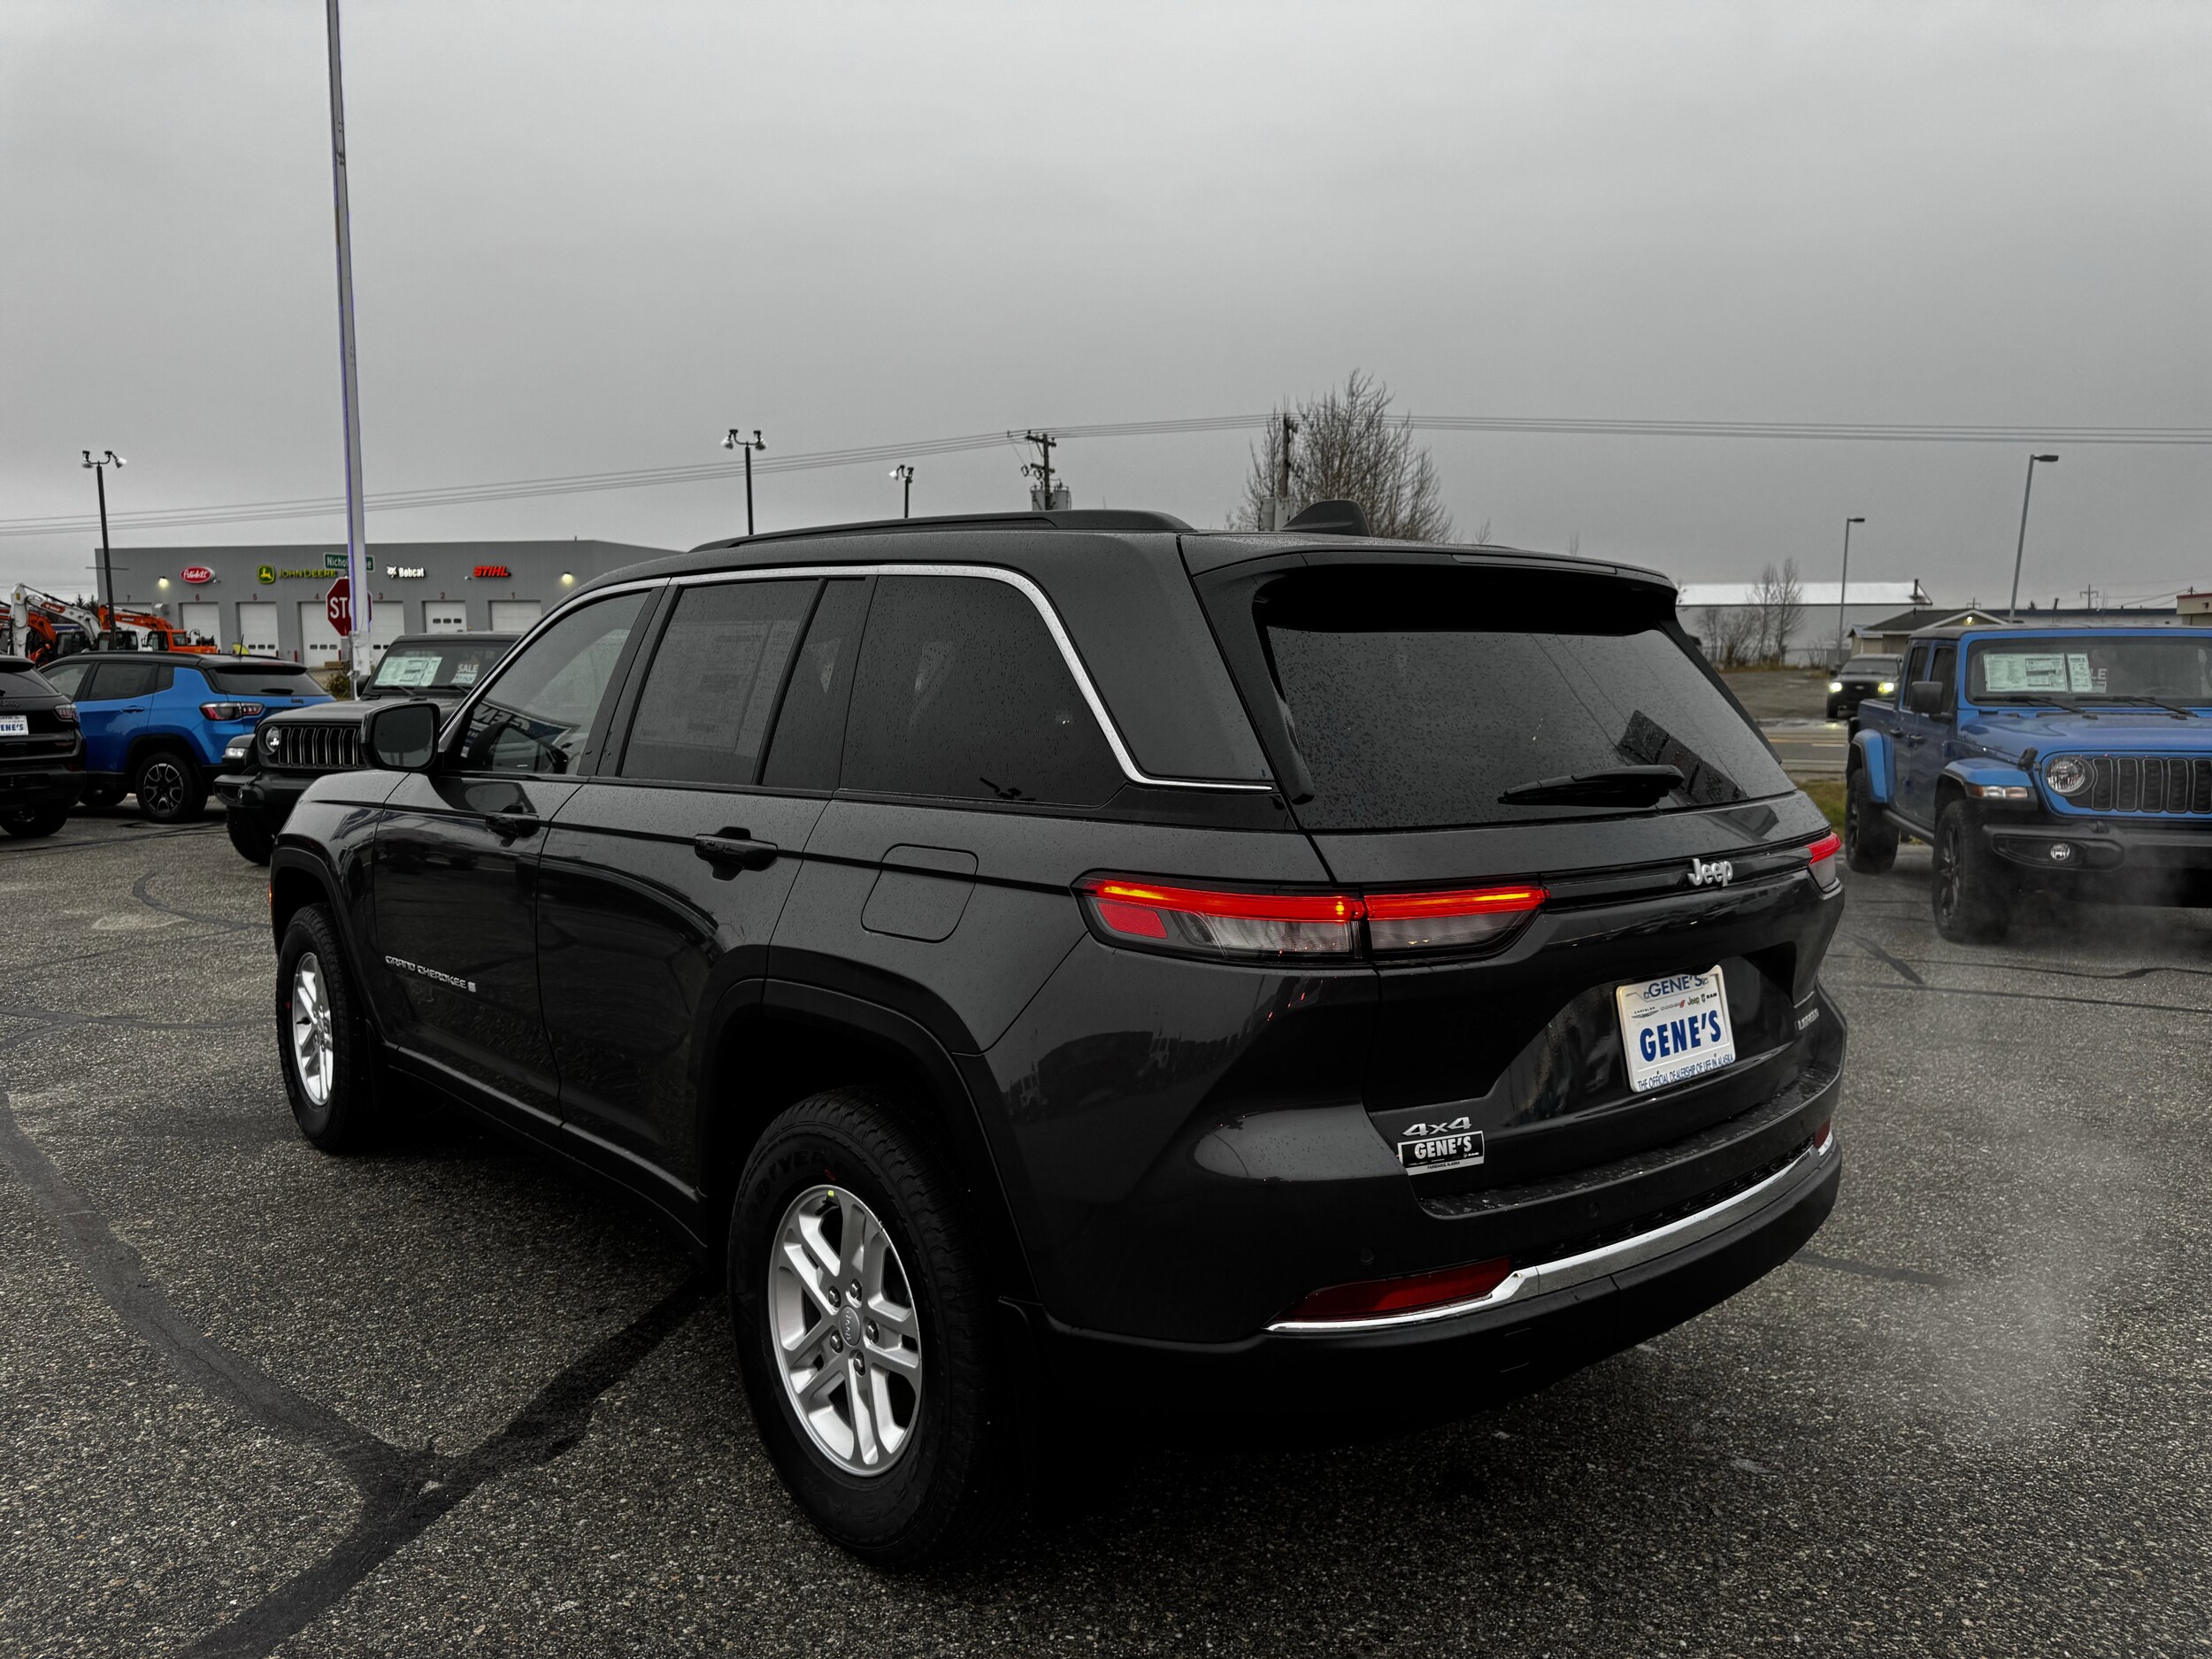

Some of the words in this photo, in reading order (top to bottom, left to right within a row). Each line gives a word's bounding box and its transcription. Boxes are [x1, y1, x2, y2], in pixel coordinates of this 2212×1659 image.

[326, 556, 349, 567] Nichol
[304, 568, 337, 578] DEERE
[398, 567, 425, 578] Bobcat
[473, 565, 509, 578] STIHL
[127, 594, 131, 603] 7
[330, 597, 352, 619] ST
[457, 664, 479, 672] SALE
[1686, 858, 1733, 887] Jeep
[385, 956, 416, 972] GRAND
[417, 965, 467, 988] CHEROKEE
[1647, 975, 1703, 998] GENE'S
[1687, 996, 1701, 1006] Jeep
[1640, 1010, 1722, 1063] GENE'S
[1638, 1079, 1647, 1091] THE
[1670, 1065, 1695, 1082] DEALERSHIP
[1696, 1062, 1702, 1073] OF
[1717, 1054, 1733, 1066] ALASKA
[1402, 1117, 1472, 1136] 4x4
[1414, 1136, 1472, 1159] GENE'S
